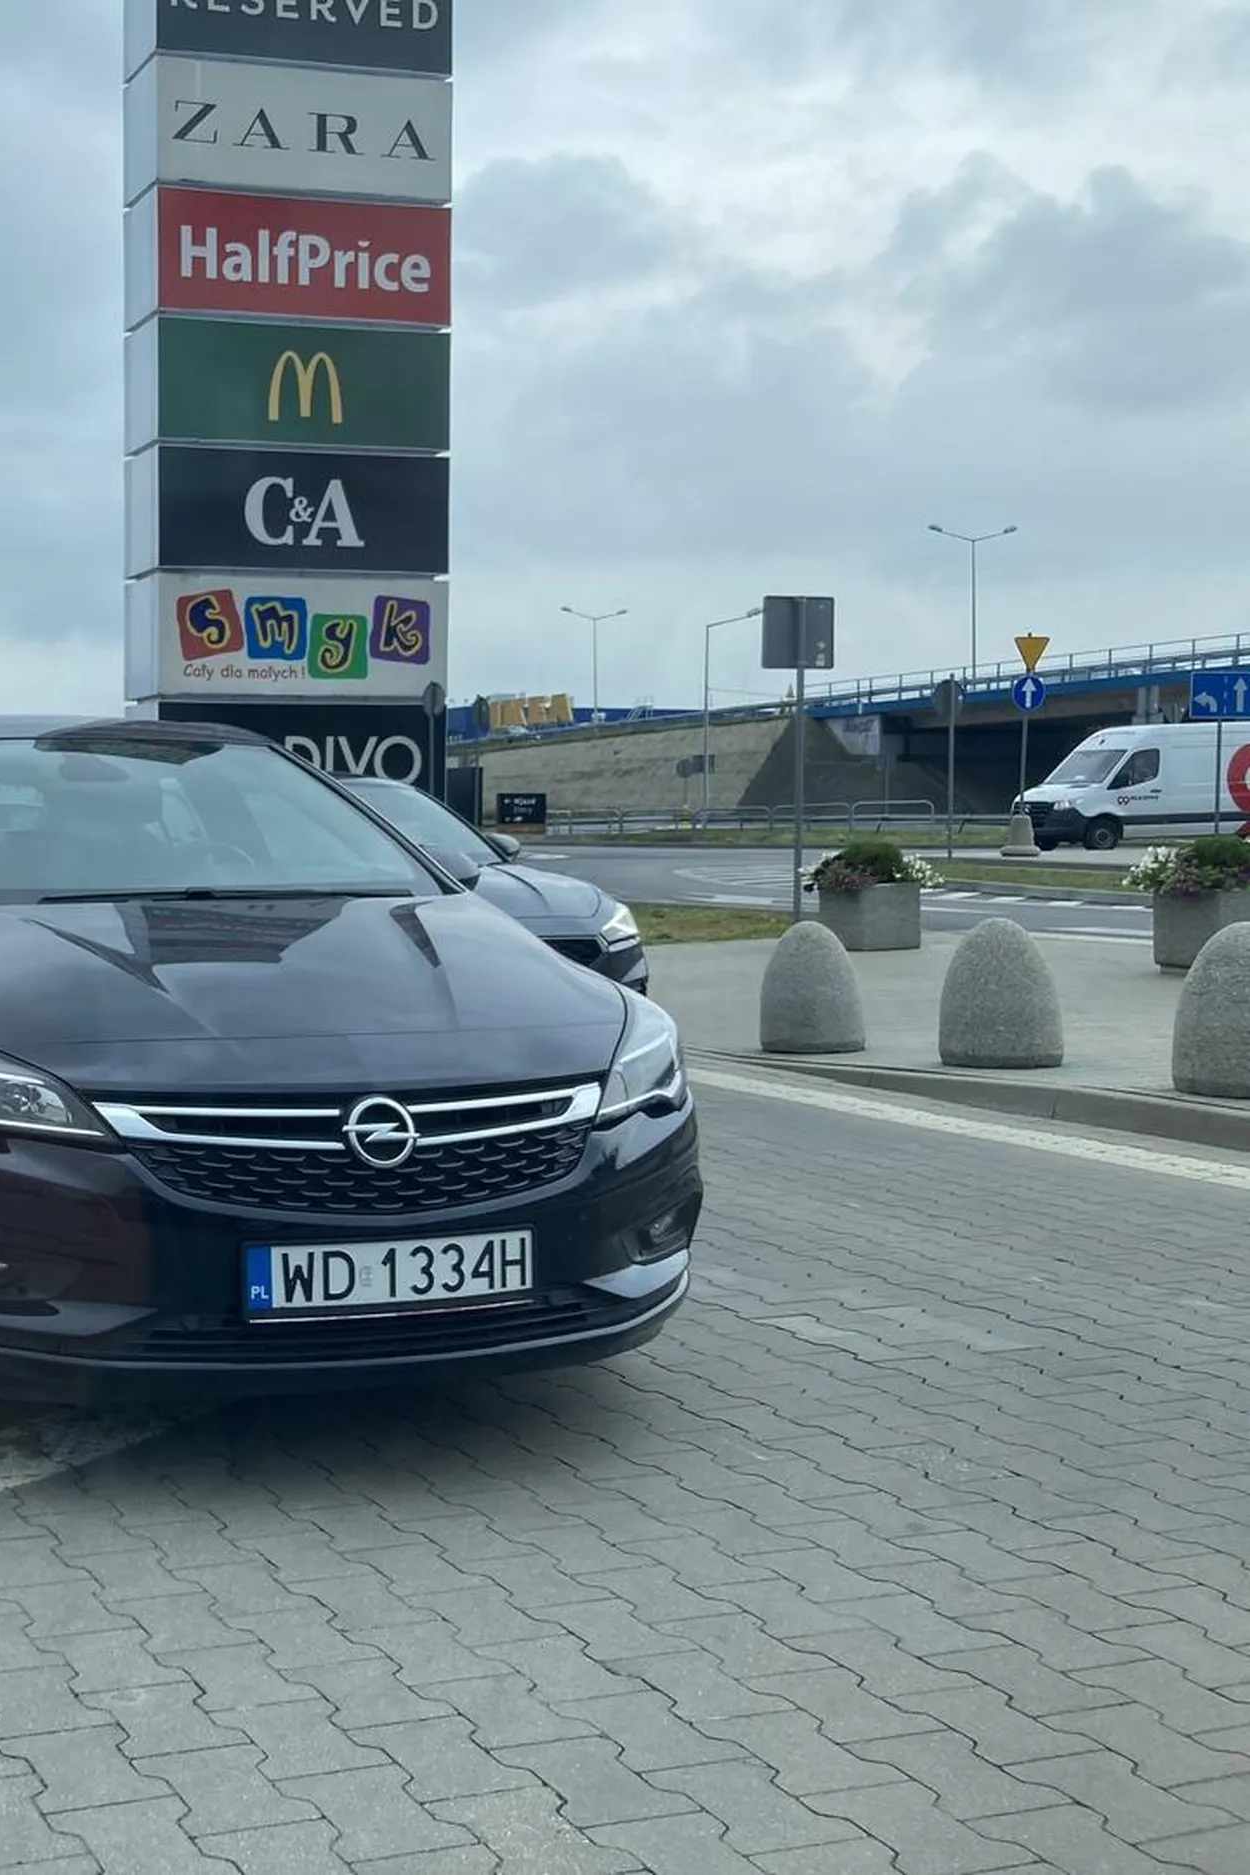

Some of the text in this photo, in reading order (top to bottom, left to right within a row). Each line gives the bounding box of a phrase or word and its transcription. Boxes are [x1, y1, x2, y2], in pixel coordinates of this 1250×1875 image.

[170, 0, 439, 29] SERVED
[172, 100, 436, 161] ZARA
[180, 225, 431, 293] HalfPrice
[244, 476, 365, 547] C&A
[186, 596, 422, 673] smyk
[220, 664, 242, 678] dla
[250, 1285, 270, 1300] PL
[281, 1237, 527, 1303] WD 1334H
